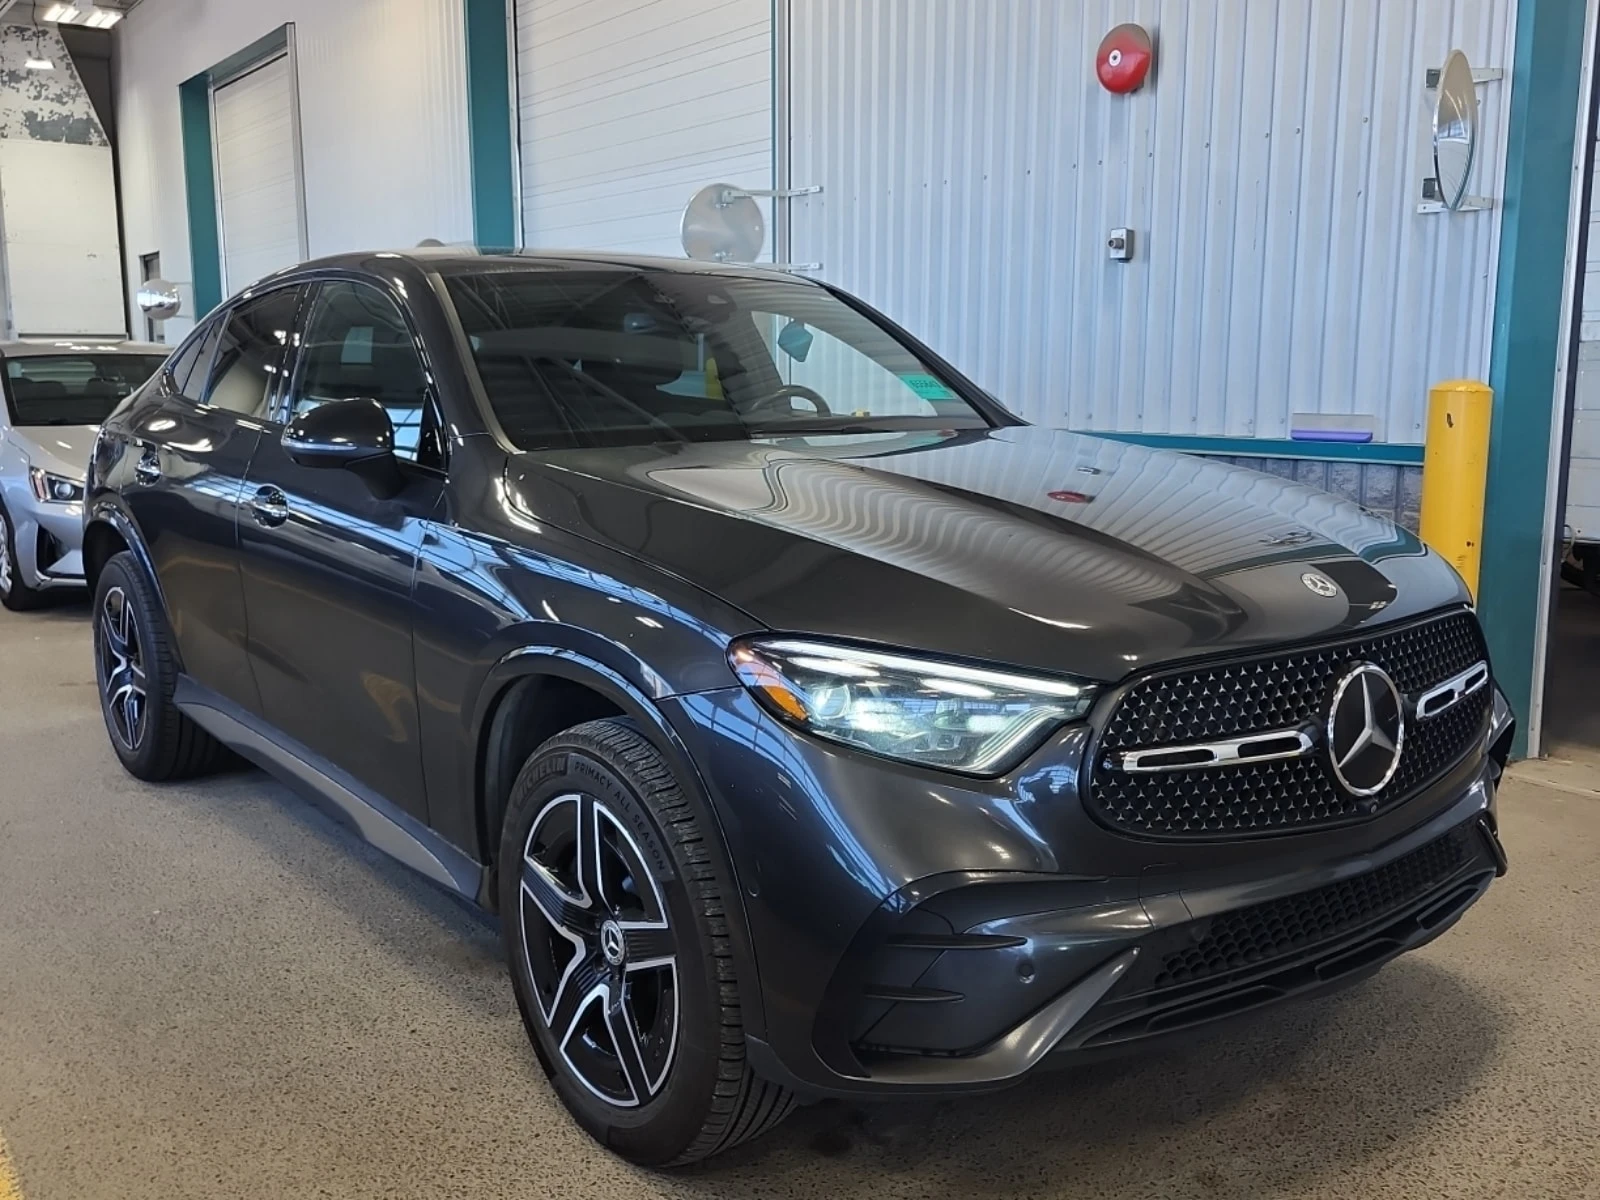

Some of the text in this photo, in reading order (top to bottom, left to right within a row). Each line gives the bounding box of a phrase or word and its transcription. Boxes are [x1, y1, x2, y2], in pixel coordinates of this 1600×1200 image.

[516, 757, 567, 804] MICHELIN
[574, 761, 666, 871] PRIMACY ALL SEASON
